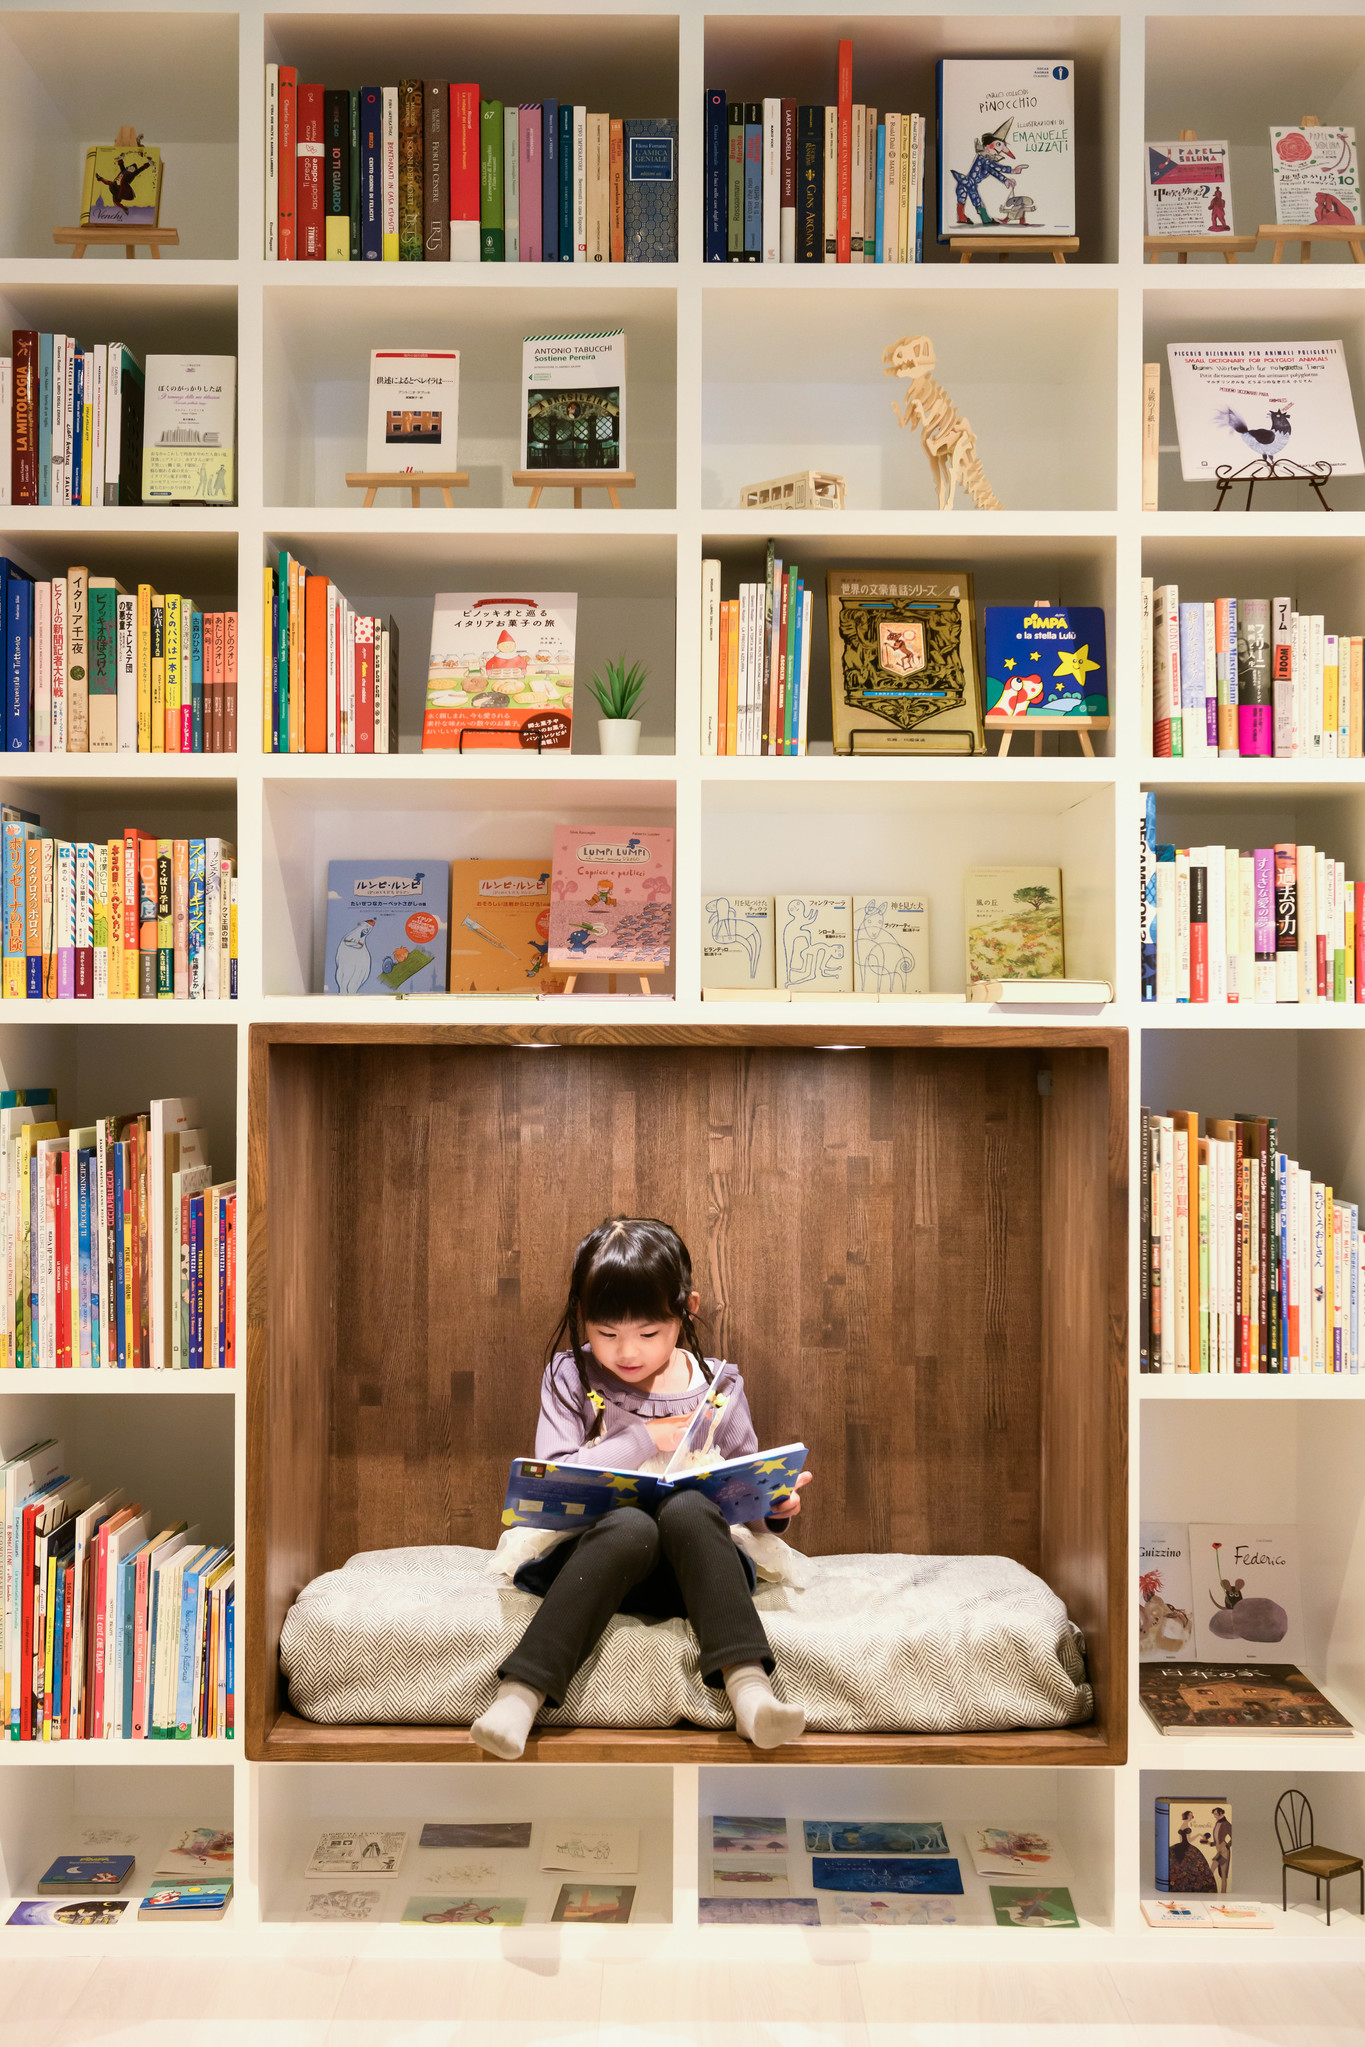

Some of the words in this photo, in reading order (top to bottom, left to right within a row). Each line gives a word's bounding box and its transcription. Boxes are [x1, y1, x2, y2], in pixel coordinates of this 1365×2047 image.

[1012, 129, 1068, 143] EMANUELE
[332, 148, 341, 158] IO
[1025, 140, 1068, 153] LUZZATI
[332, 159, 341, 169] TI
[1179, 155, 1217, 163] SOLUNA
[433, 163, 439, 172] DI
[387, 181, 394, 189] IN
[1338, 175, 1355, 186] 10
[332, 171, 341, 212] GUARDO
[806, 184, 816, 208] GENS
[93, 208, 123, 219] Venchi
[806, 211, 814, 246] ARCANA
[534, 346, 572, 355] ANTONIO
[574, 344, 613, 354] TABUCCHI
[534, 354, 567, 363] Sostiene
[569, 353, 596, 361] Pereira
[158, 385, 222, 393] ぼくのがっかりした話
[16, 366, 28, 434] MITOLOGIA
[547, 393, 610, 409] BRASILEIRA
[16, 437, 28, 451] LA
[71, 576, 84, 655] イタリア千一夜
[118, 601, 126, 631] の悪童
[463, 610, 548, 618] ピノッキオと巡る
[454, 619, 555, 628] イタリアお菓子の旅
[96, 593, 107, 678] ピノッキオのぼうけん
[204, 617, 212, 646] 青矢号
[1024, 631, 1032, 639] la
[1034, 631, 1057, 639] stella
[1059, 631, 1076, 640] Lulù
[192, 618, 200, 662] 古森のひみつ
[1254, 624, 1270, 668] フェリーニ
[583, 847, 613, 857] LUMPI
[616, 847, 646, 857] LUMPI
[44, 843, 53, 904] ラウラの日記
[577, 866, 609, 878] Capricci
[159, 860, 169, 913] よくばり学園
[189, 844, 204, 934] スーパーキッズ
[356, 880, 423, 890] ルンピ・ルンピ
[481, 880, 546, 890] ルンピ・ルンピ
[9, 836, 24, 953] ポリッセーナの冒険
[28, 847, 39, 938] ケンタウロスのポロス
[111, 845, 120, 942] ネコの目からのぞいたら
[1257, 857, 1271, 928] すてきな愛の夢
[733, 899, 768, 907] 月を見つけた
[808, 899, 846, 907] フォンタマーラ
[890, 901, 924, 911] 神を見た犬
[975, 899, 999, 907] 風の丘
[1277, 867, 1296, 936] 過去の力
[192, 957, 200, 989] 佐藤まどか
[1176, 1139, 1188, 1219] ピノキオの冒険
[198, 1289, 203, 1297] AL
[1140, 1547, 1181, 1558] Guizzino
[1234, 1545, 1286, 1566] Federico
[96, 1622, 104, 1637] COSE
[181, 1609, 191, 1652] buongiorno
[96, 1638, 104, 1650] CHE
[137, 1633, 142, 1645] ma
[136, 1646, 144, 1665] lupo,
[135, 1666, 144, 1683] Lupo
[181, 1654, 190, 1683] fattoria!
